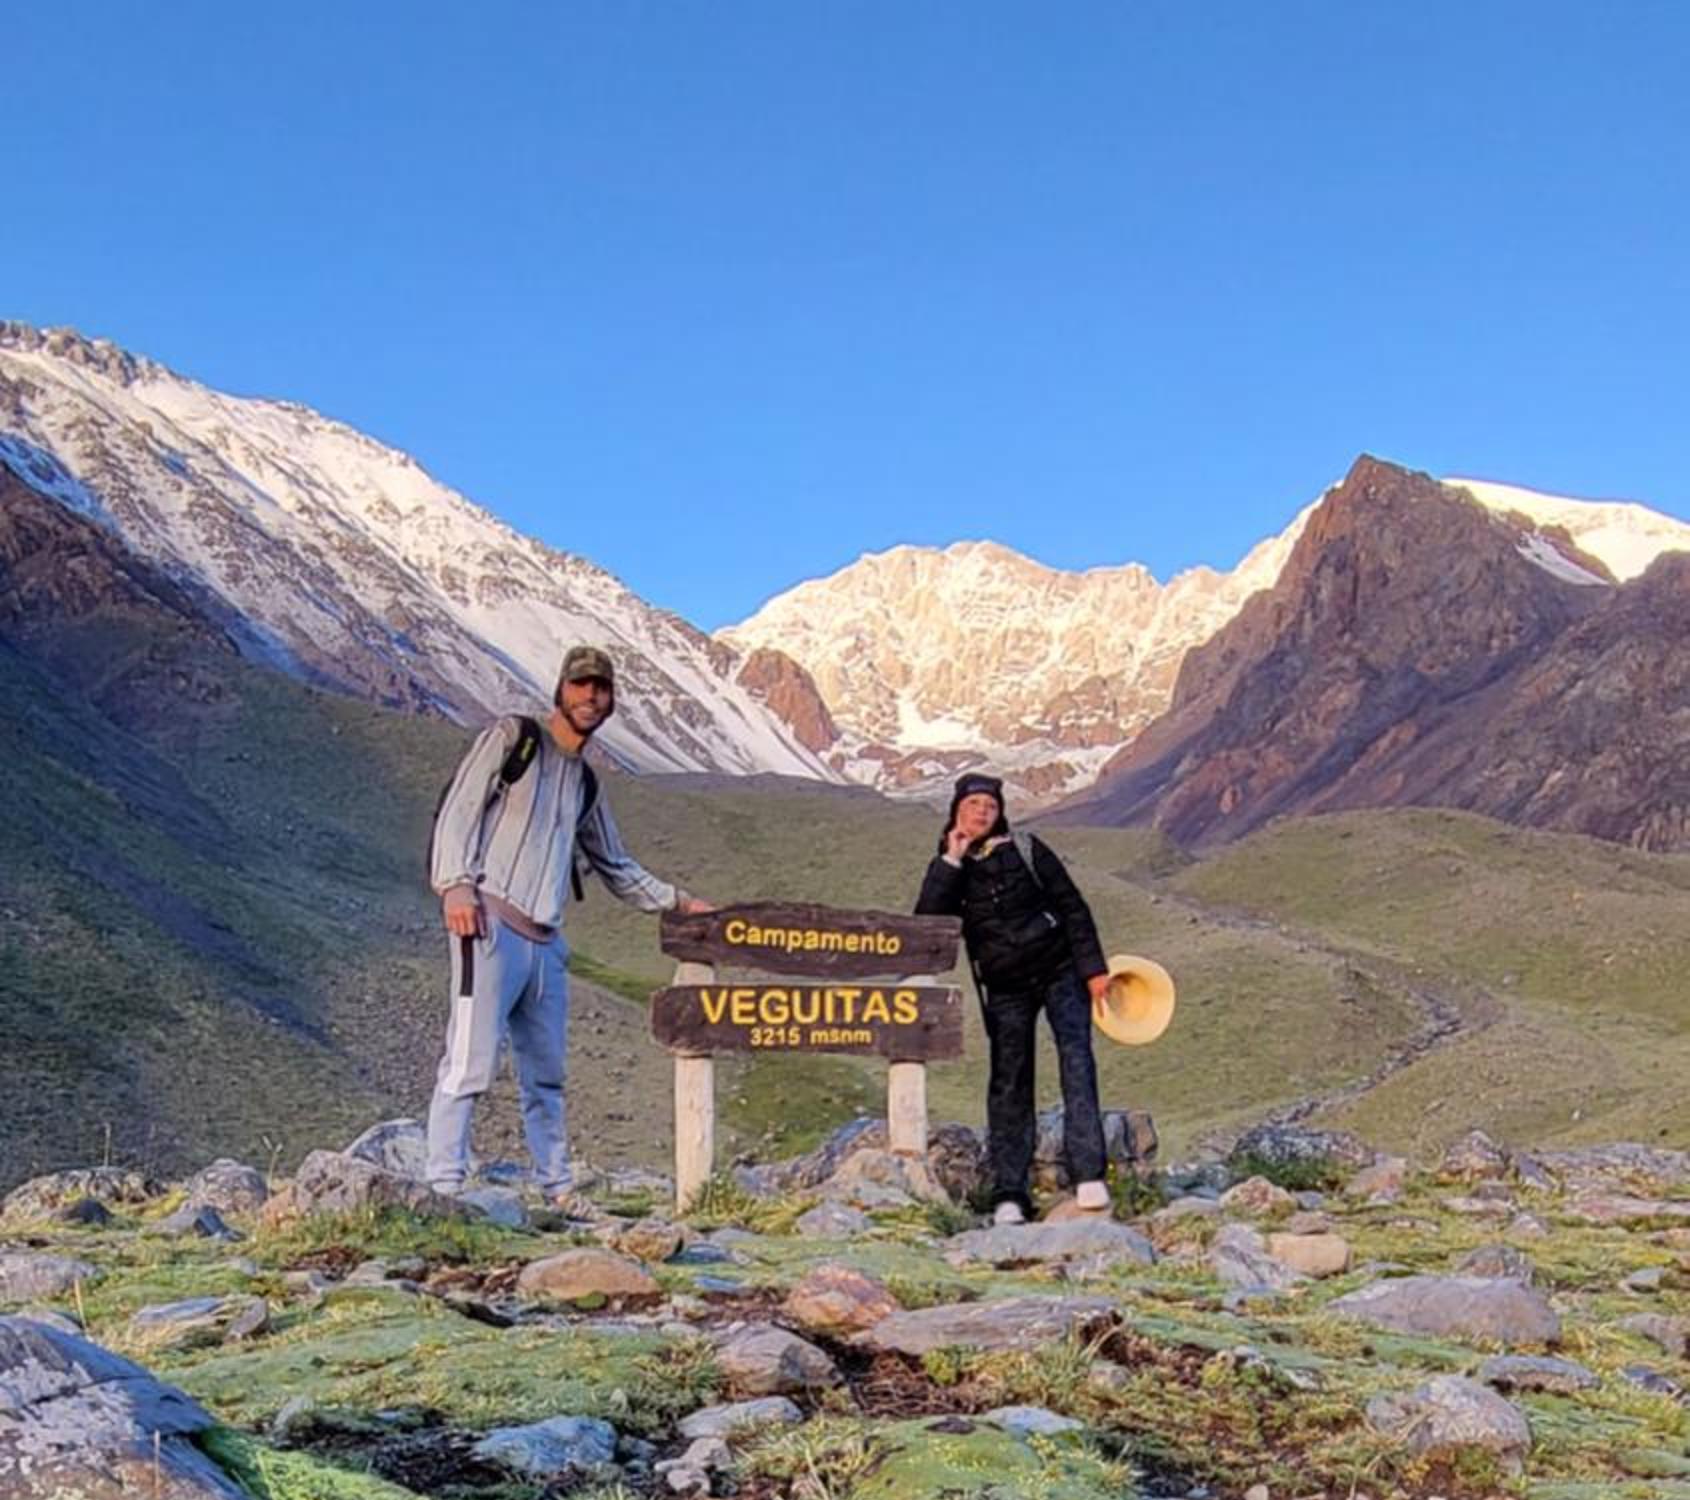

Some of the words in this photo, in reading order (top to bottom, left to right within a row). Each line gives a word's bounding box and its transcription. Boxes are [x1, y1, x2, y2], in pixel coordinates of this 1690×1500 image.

[725, 920, 901, 954] Campamento
[700, 989, 919, 1024] VEGUITAS
[750, 1027, 801, 1046] 3215
[810, 1028, 872, 1044] msnm
